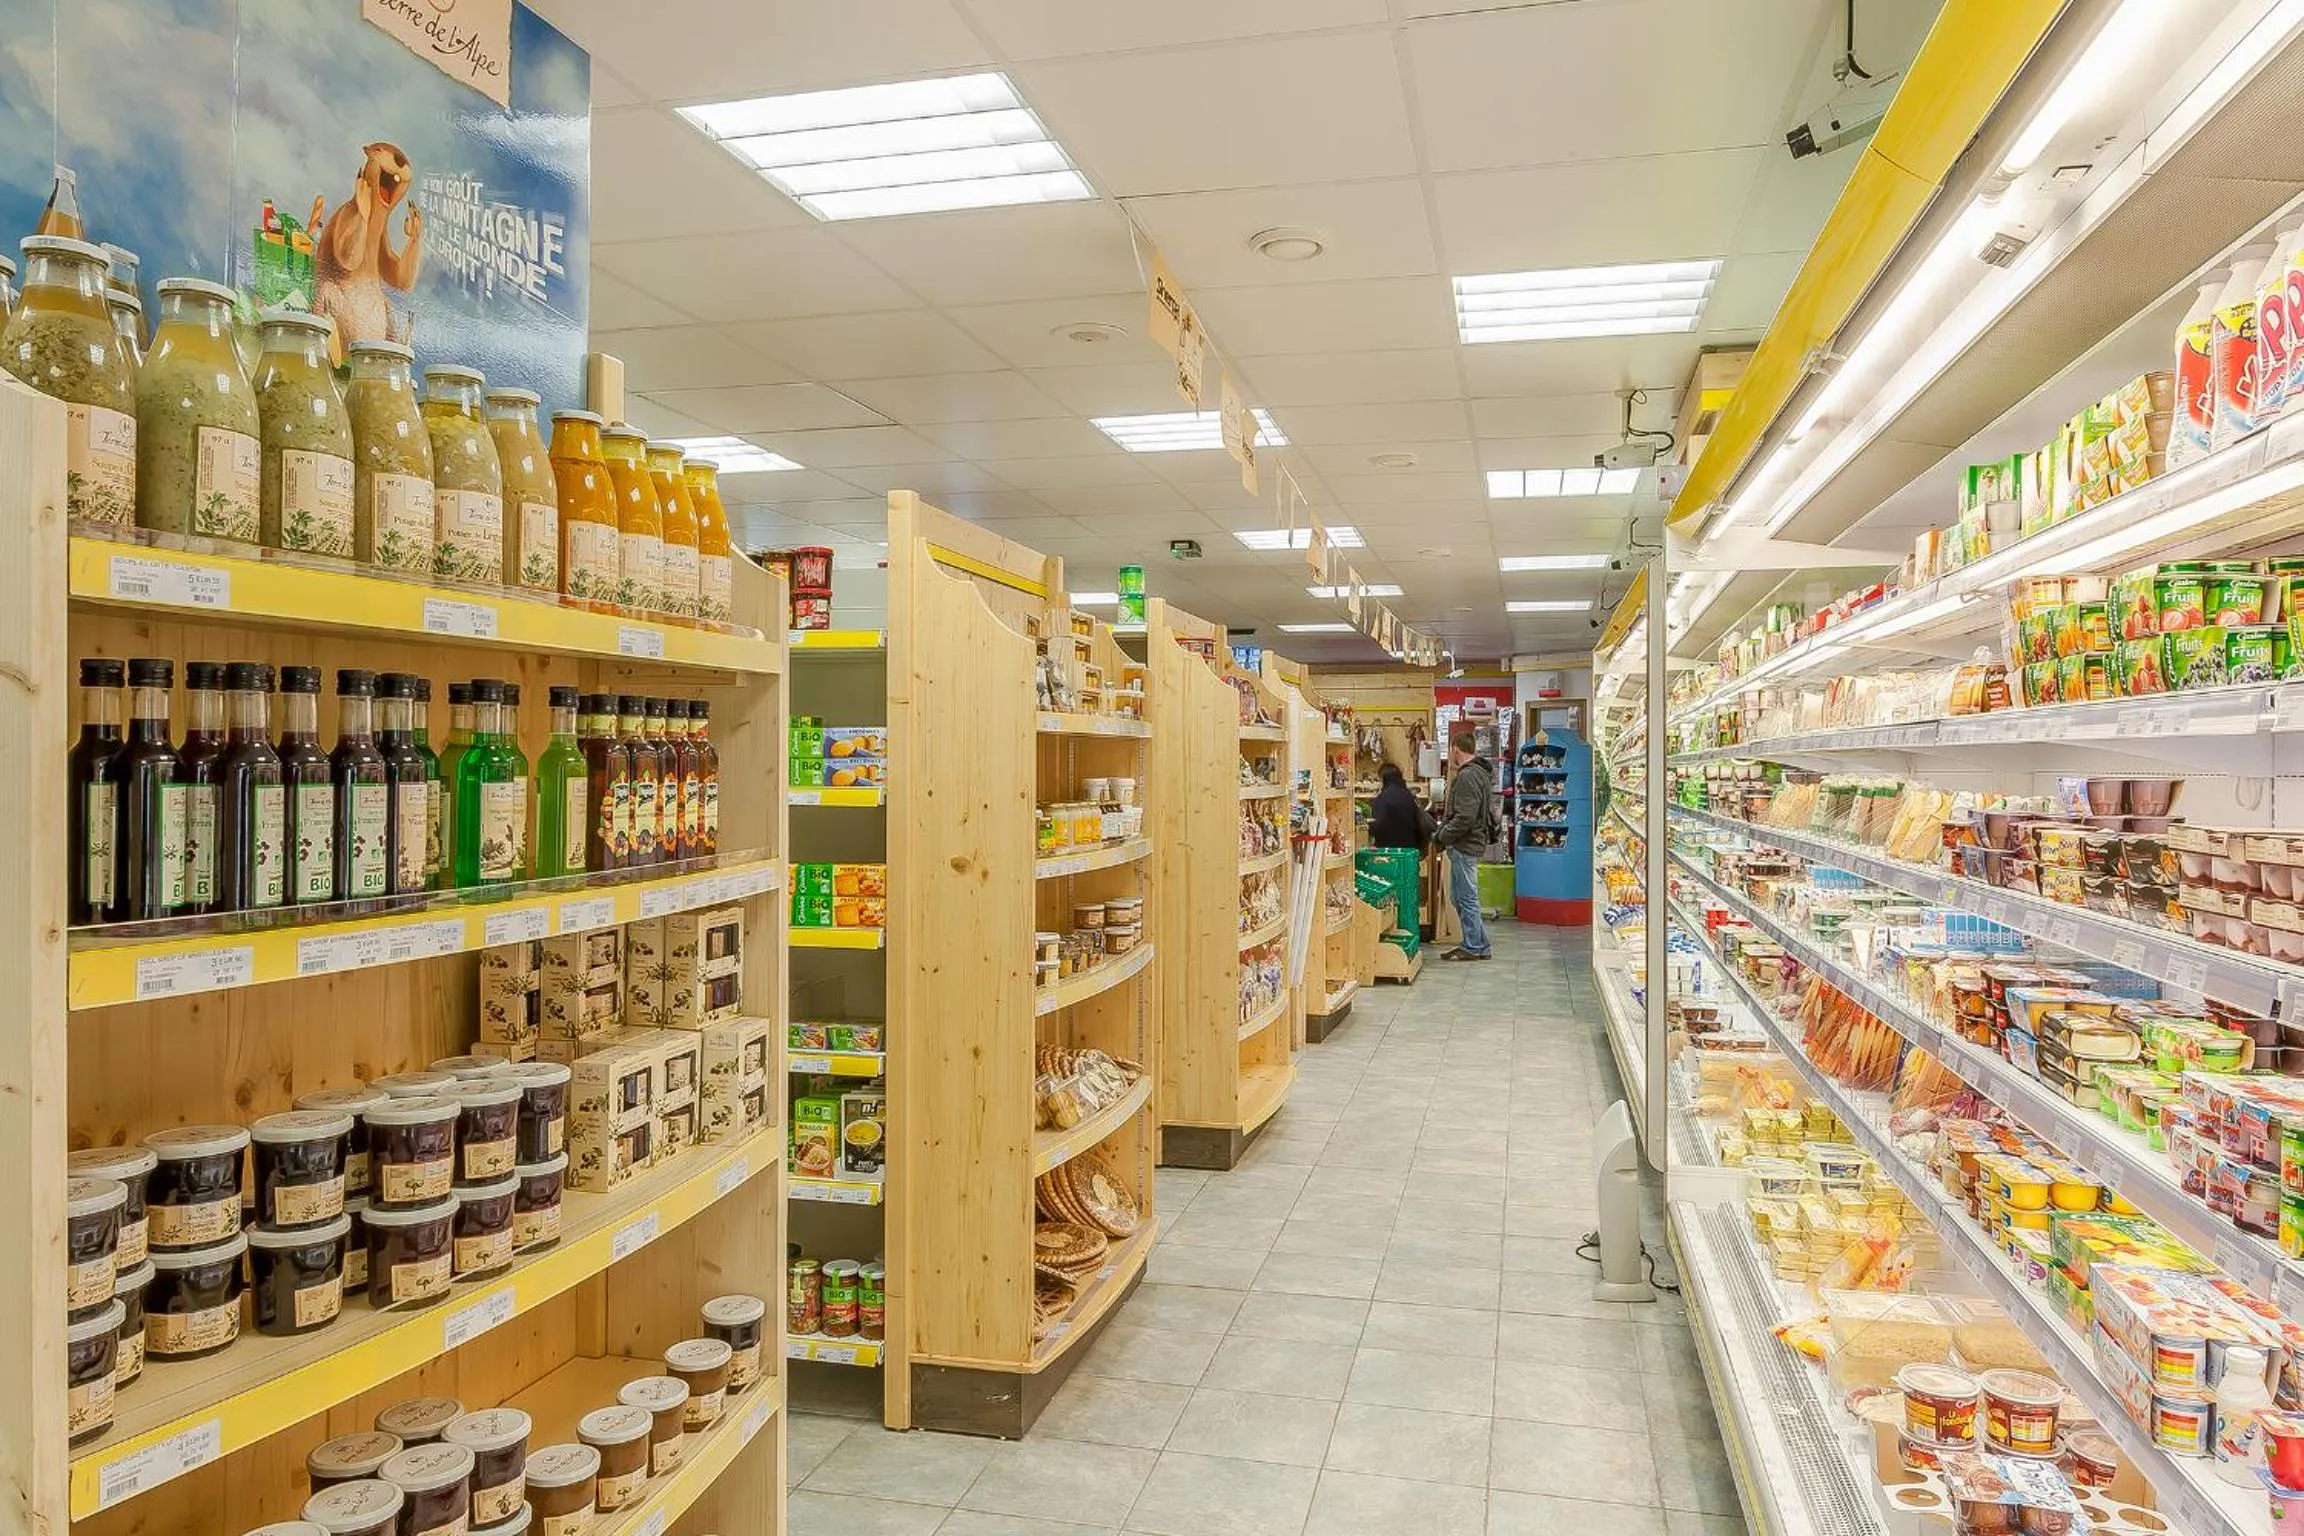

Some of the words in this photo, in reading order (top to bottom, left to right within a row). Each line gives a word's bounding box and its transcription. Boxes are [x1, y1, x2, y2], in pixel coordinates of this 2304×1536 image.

[379, 0, 423, 27] erre
[425, 14, 447, 42] de
[446, 171, 484, 204] GOÛT
[443, 200, 565, 276] MONTAGNE
[466, 232, 548, 301] MONDE
[294, 457, 305, 465] 97
[801, 732, 820, 741] BiO
[802, 761, 821, 770] BiO
[811, 869, 829, 879] BiO
[310, 877, 331, 891] BIO
[364, 874, 384, 888] BIO
[810, 899, 829, 909] BiO
[804, 1106, 822, 1116] BiO
